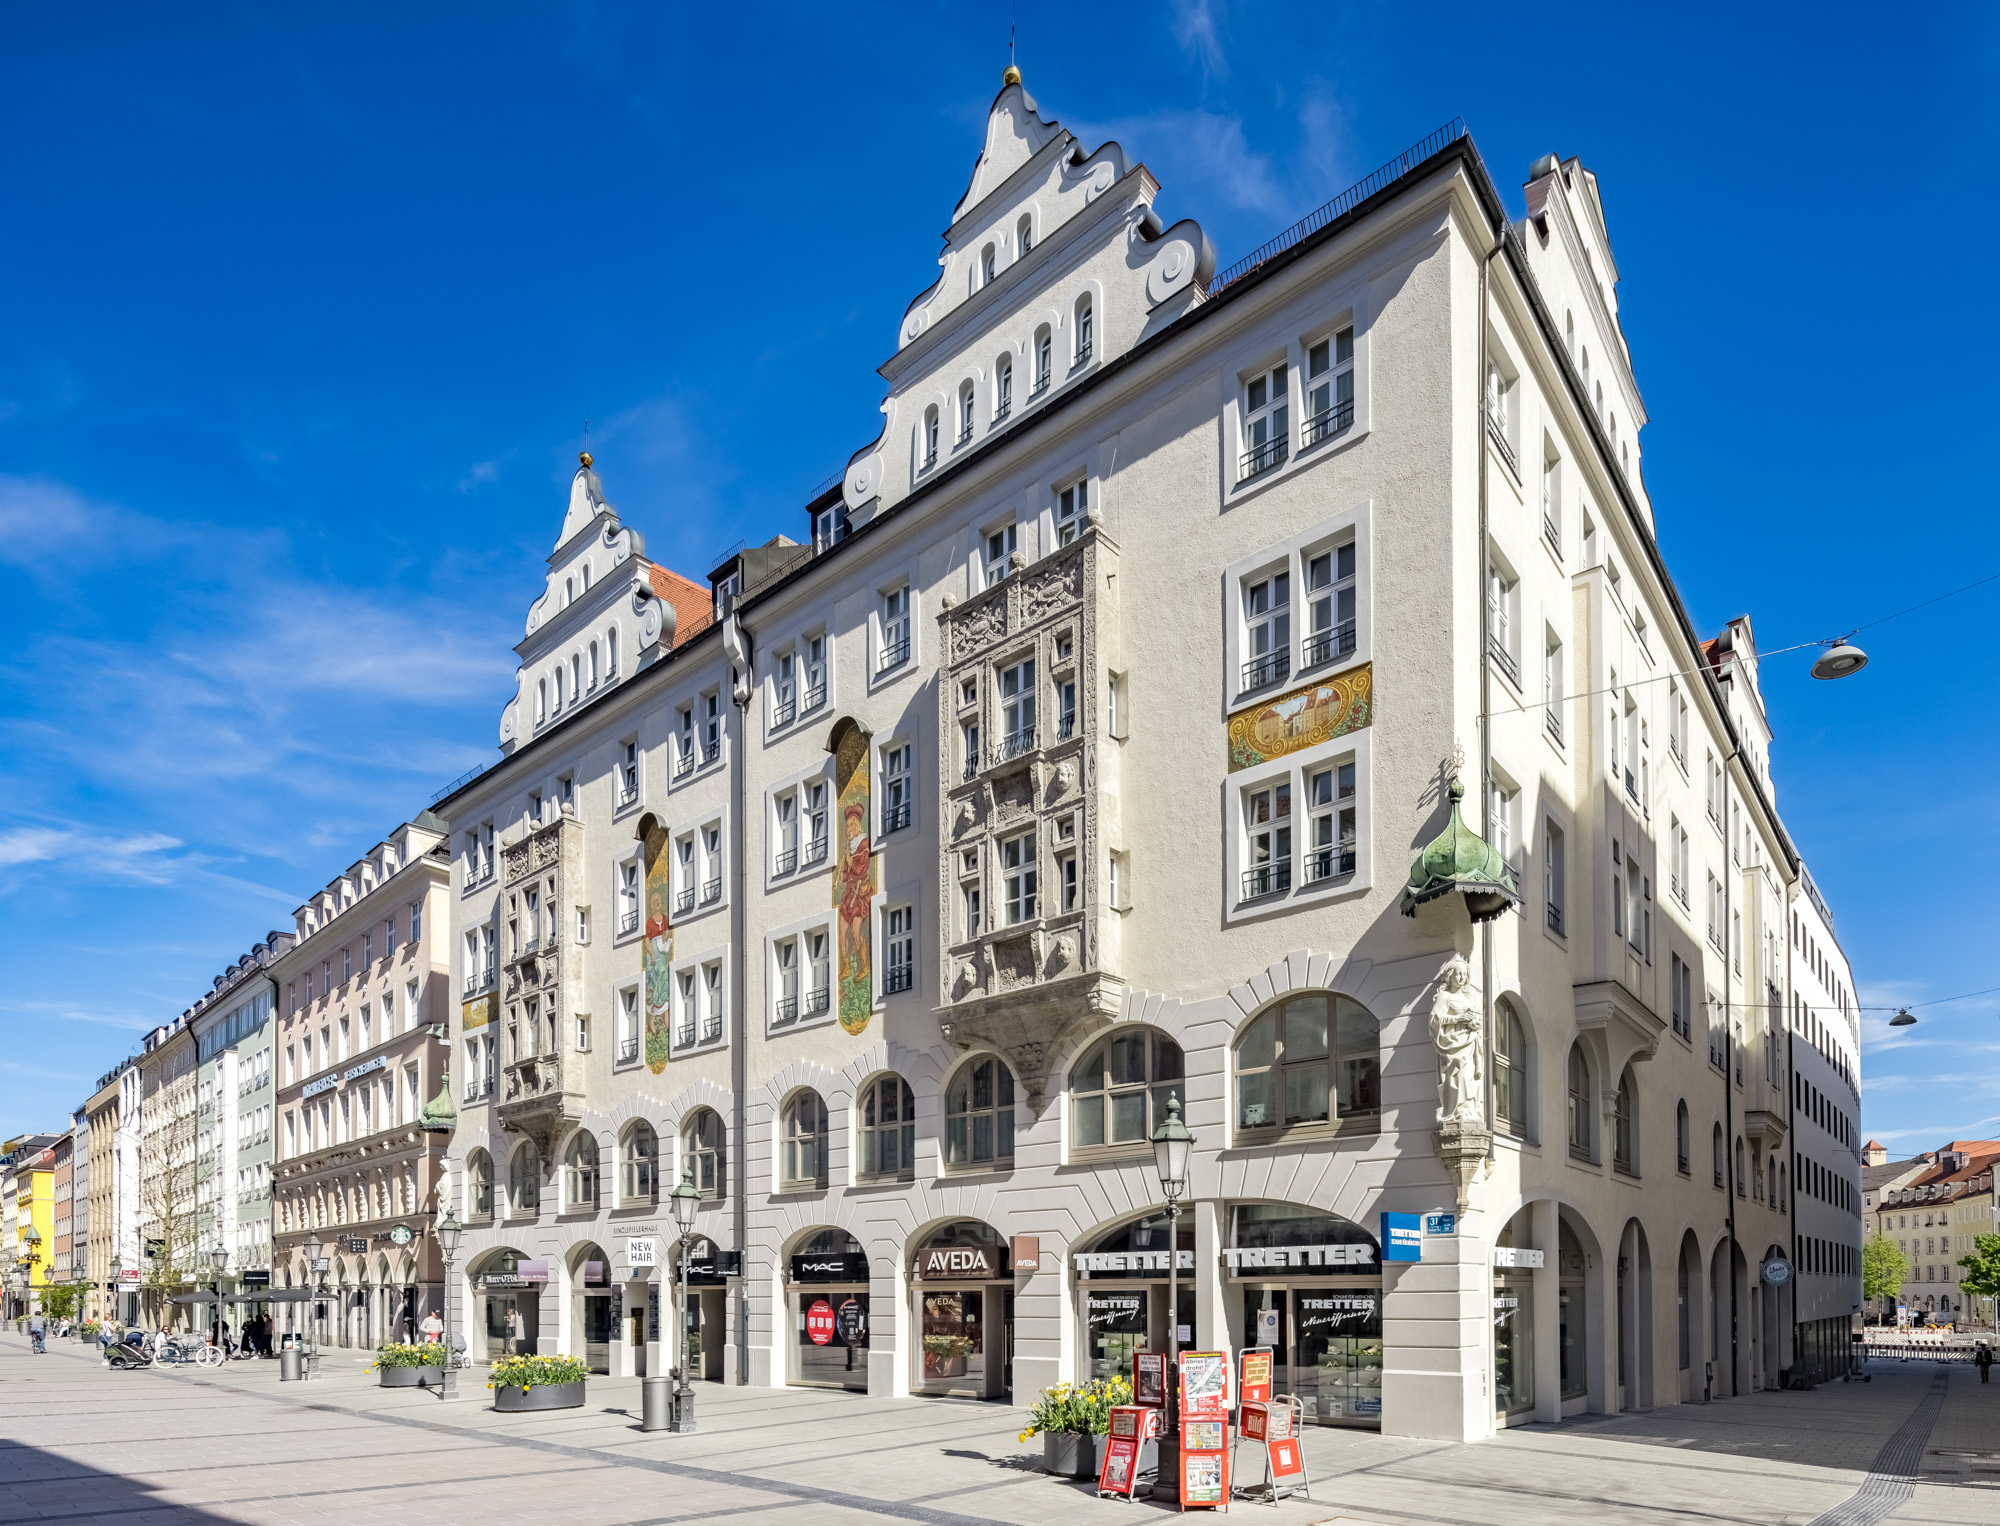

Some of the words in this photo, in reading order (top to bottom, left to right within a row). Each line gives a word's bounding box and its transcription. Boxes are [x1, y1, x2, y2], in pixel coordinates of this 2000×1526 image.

[1390, 1227, 1421, 1239] TRETTER
[631, 1242, 652, 1251] NEW
[631, 1253, 652, 1262] HAIR
[927, 1250, 988, 1271] AVEDA
[1072, 1250, 1196, 1271] TRETTER
[1222, 1243, 1375, 1267] TRETTER
[802, 1263, 844, 1272] MAC
[926, 1298, 955, 1306] AVEDA
[1085, 1300, 1140, 1309] TRETTER
[1302, 1299, 1375, 1310] TRETTER
[1086, 1308, 1139, 1324] Neueröffnung
[1303, 1308, 1375, 1327] Neueröffnung
